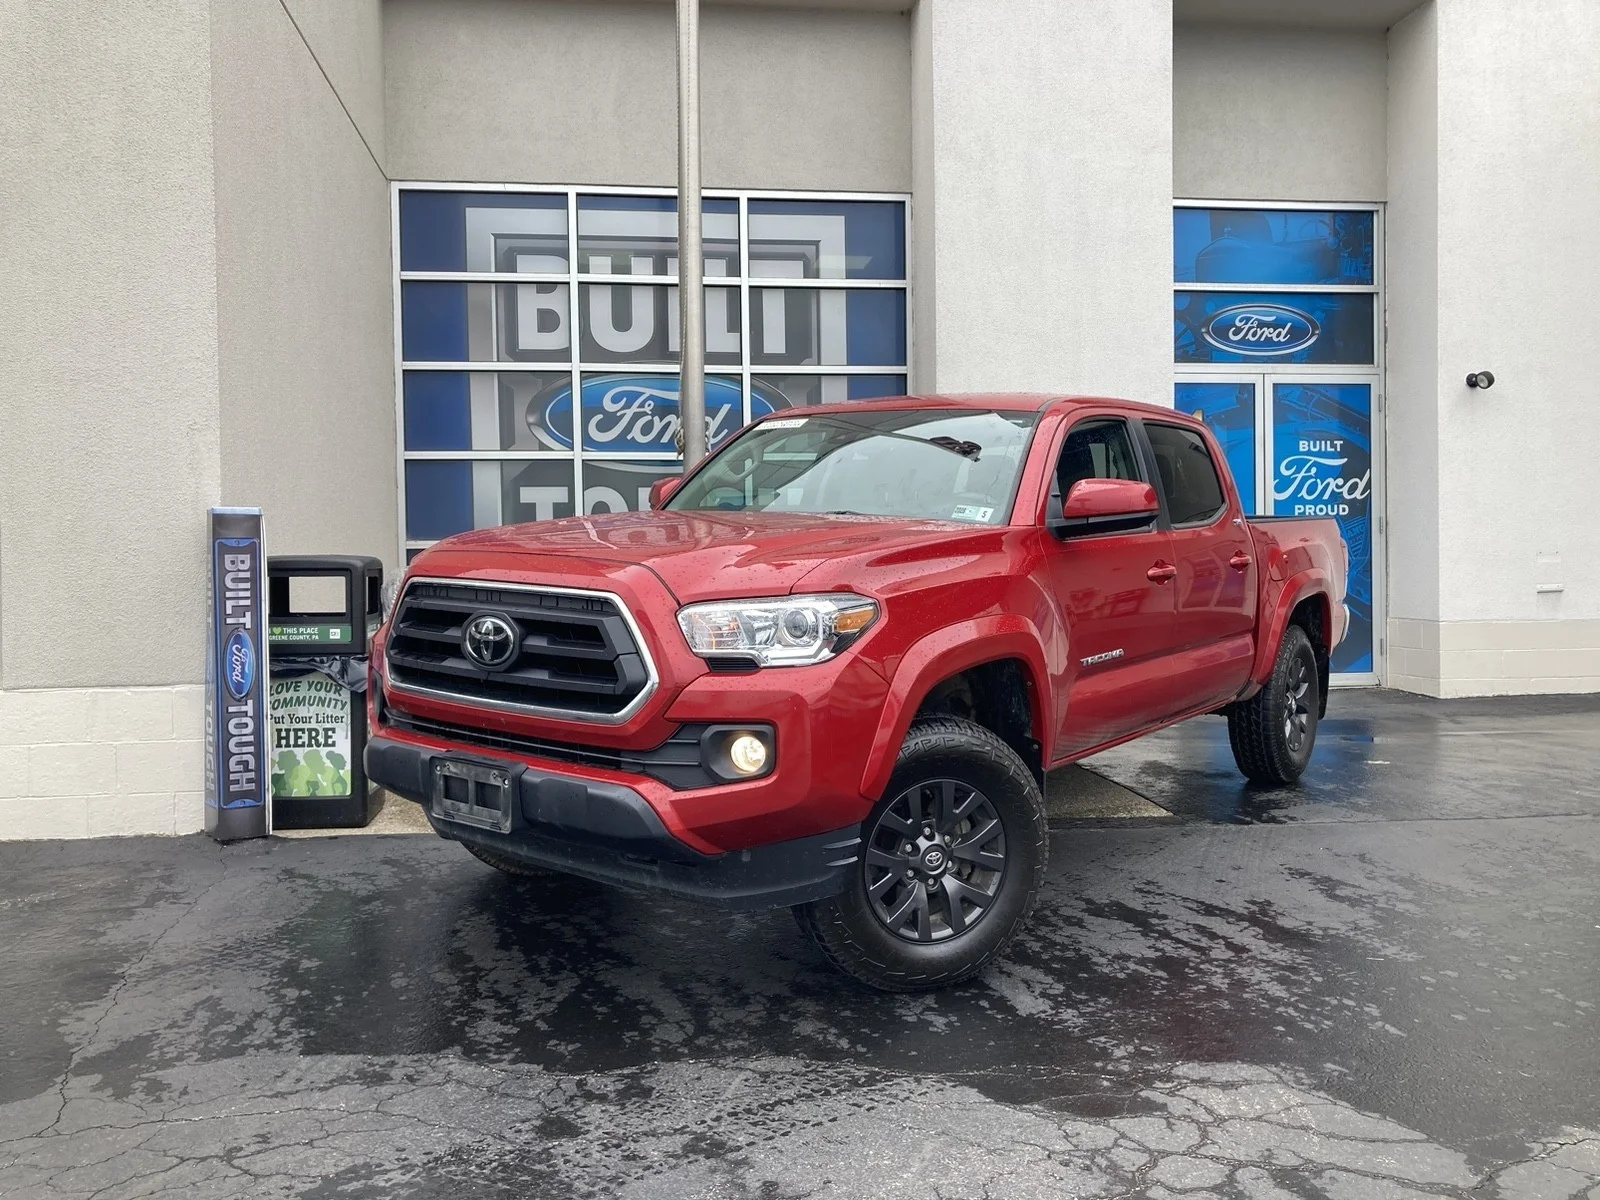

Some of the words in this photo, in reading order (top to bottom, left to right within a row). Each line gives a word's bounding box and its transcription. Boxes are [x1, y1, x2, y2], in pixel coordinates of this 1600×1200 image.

[1228, 314, 1292, 342] Ford
[1299, 440, 1344, 452] BUILT
[1273, 455, 1371, 500] Ford
[1294, 504, 1349, 516] PROUD
[224, 554, 252, 629] BUILT
[232, 644, 249, 683] Ford
[1080, 648, 1125, 666] TACOMA
[270, 681, 302, 697] LOVE
[307, 681, 343, 698] YOUR
[270, 695, 348, 711] OMMUNITY
[288, 713, 313, 725] Your
[315, 713, 345, 724] Litter
[228, 699, 255, 792] TOUGH
[275, 727, 337, 749] HERE
